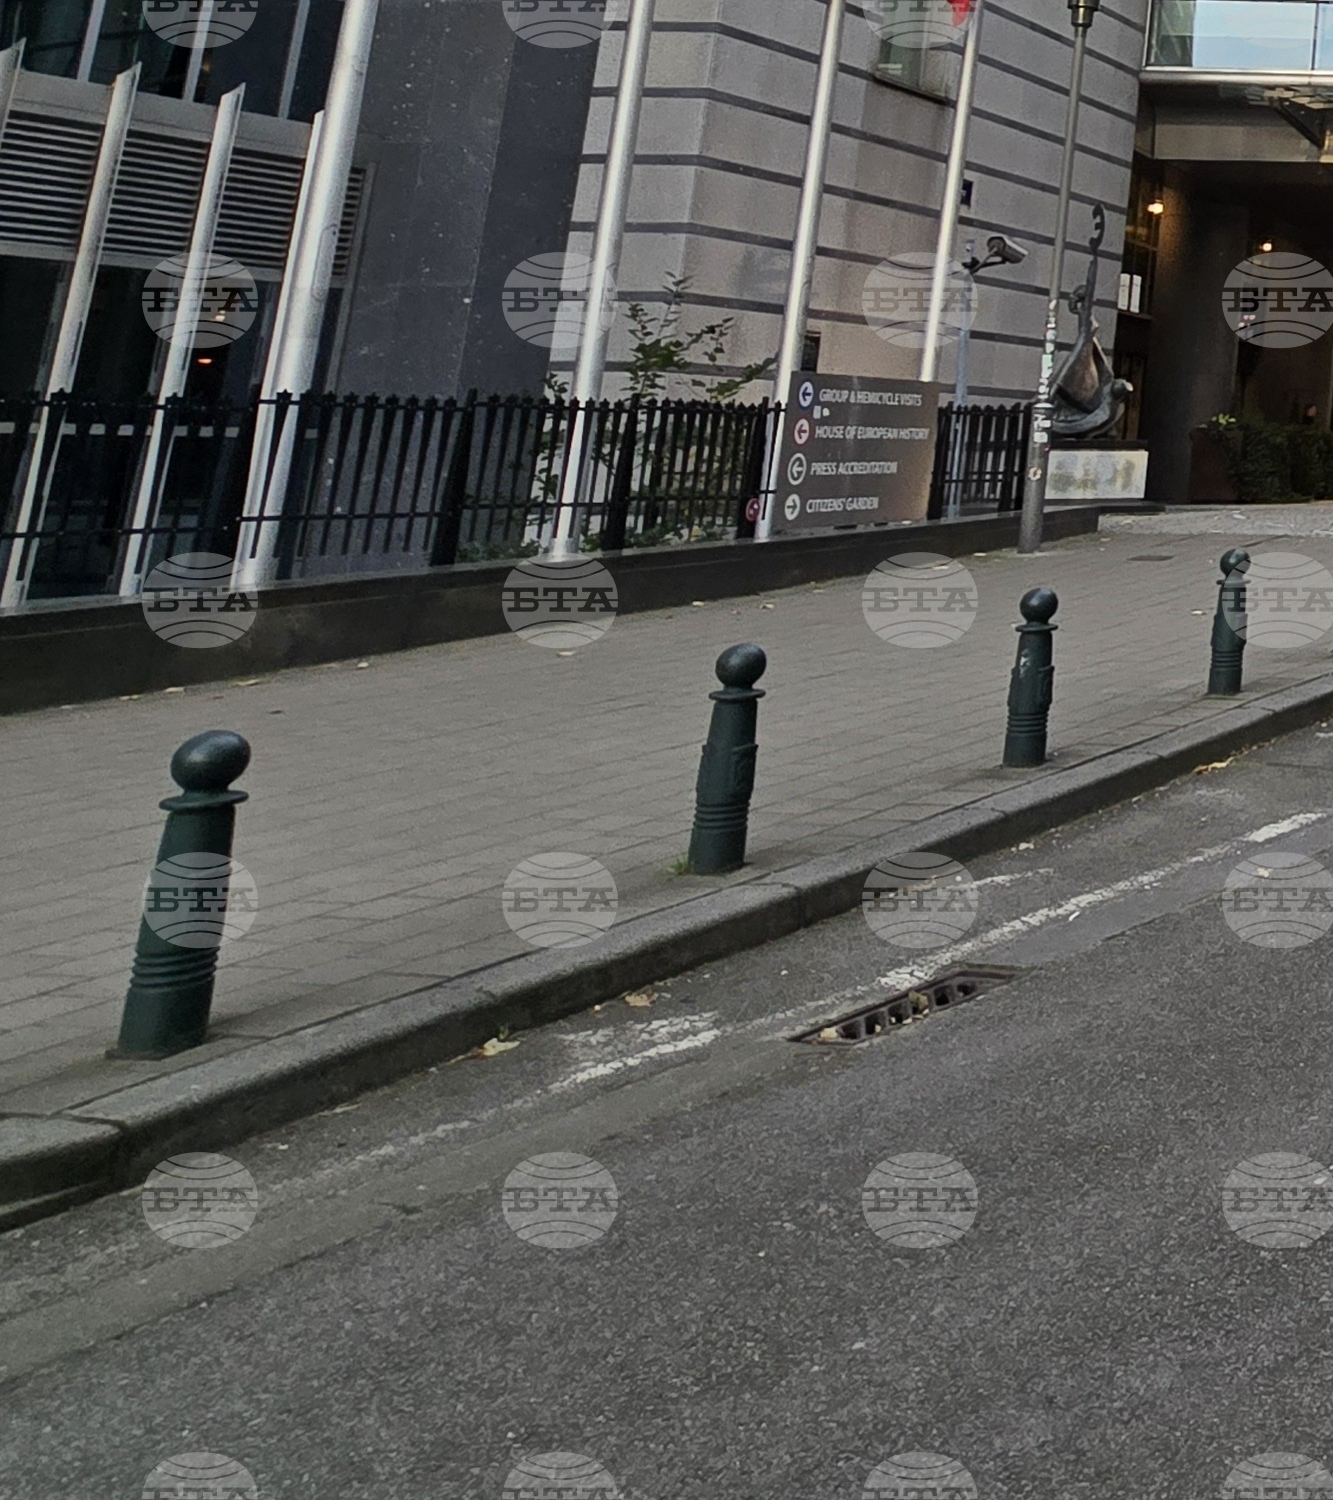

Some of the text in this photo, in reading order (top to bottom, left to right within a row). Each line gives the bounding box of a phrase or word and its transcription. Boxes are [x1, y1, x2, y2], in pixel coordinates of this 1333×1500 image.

[819, 389, 923, 407] GROUP & HEMICYCLE VISITS
[815, 425, 930, 440] HOUSE OF EUROPEAN HISTORY
[810, 461, 898, 476] PRESS ACCREDITATION
[846, 497, 879, 511] GARDEN
